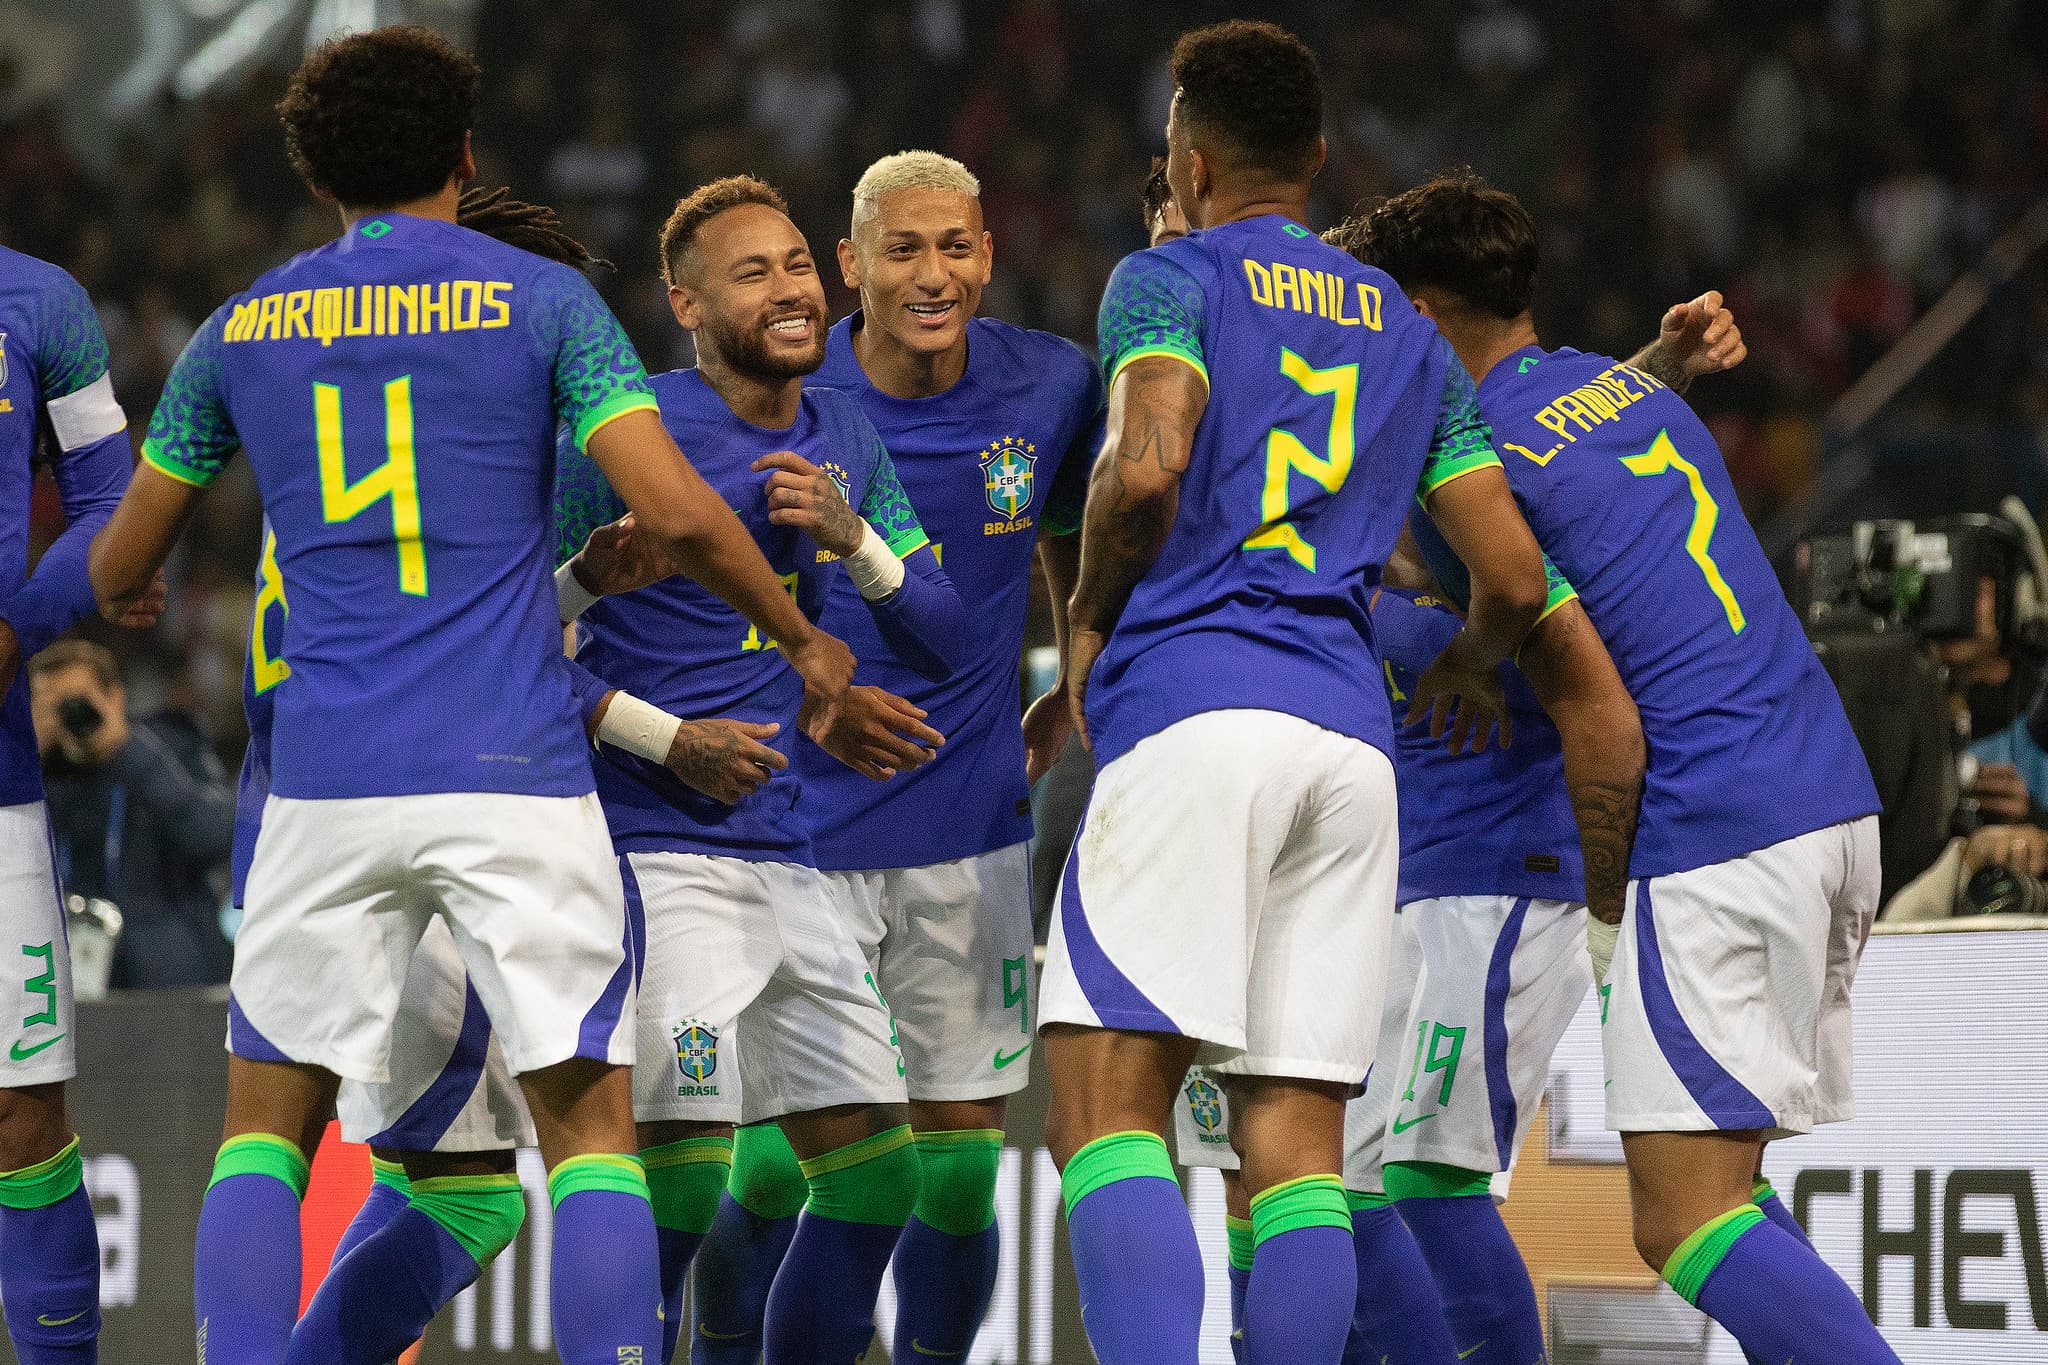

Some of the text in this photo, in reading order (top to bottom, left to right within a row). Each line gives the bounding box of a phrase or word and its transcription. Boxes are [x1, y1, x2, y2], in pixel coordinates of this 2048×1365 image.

[222, 280, 514, 347] MARQUINHOS
[1243, 258, 1383, 332] DANILO
[312, 373, 429, 598] 4
[1000, 476, 1020, 486] CBF
[1242, 345, 1360, 574] 2
[815, 550, 841, 563] BRA
[983, 516, 1033, 536] BRASIL
[1617, 427, 1748, 636] 7
[22, 941, 56, 1028] 3
[1002, 954, 1028, 1034] 9
[688, 1049, 705, 1057] CBF
[1401, 1020, 1467, 1107] 19
[678, 1085, 720, 1097] BRASIL
